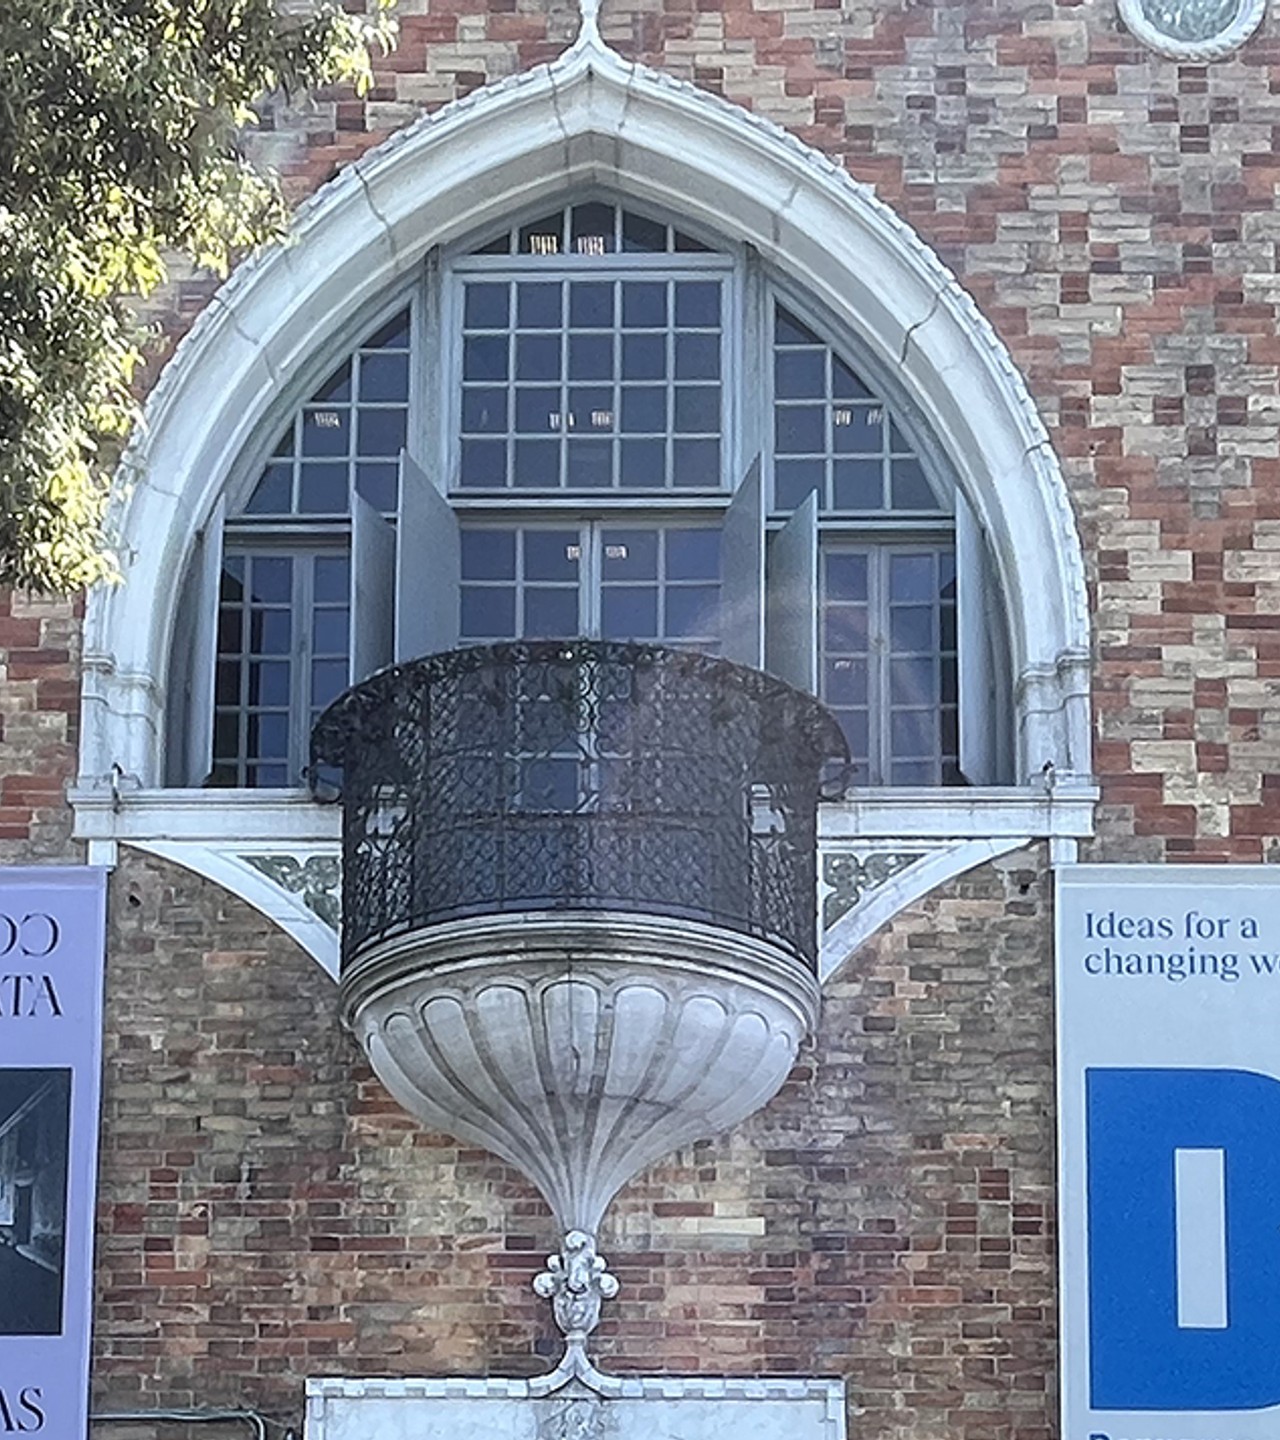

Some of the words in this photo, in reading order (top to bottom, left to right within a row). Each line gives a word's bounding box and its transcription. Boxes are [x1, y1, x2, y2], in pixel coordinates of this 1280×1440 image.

[1085, 912, 1173, 939] Ideas
[1185, 911, 1230, 939] for
[1240, 917, 1259, 939] a
[1085, 946, 1240, 982] changing
